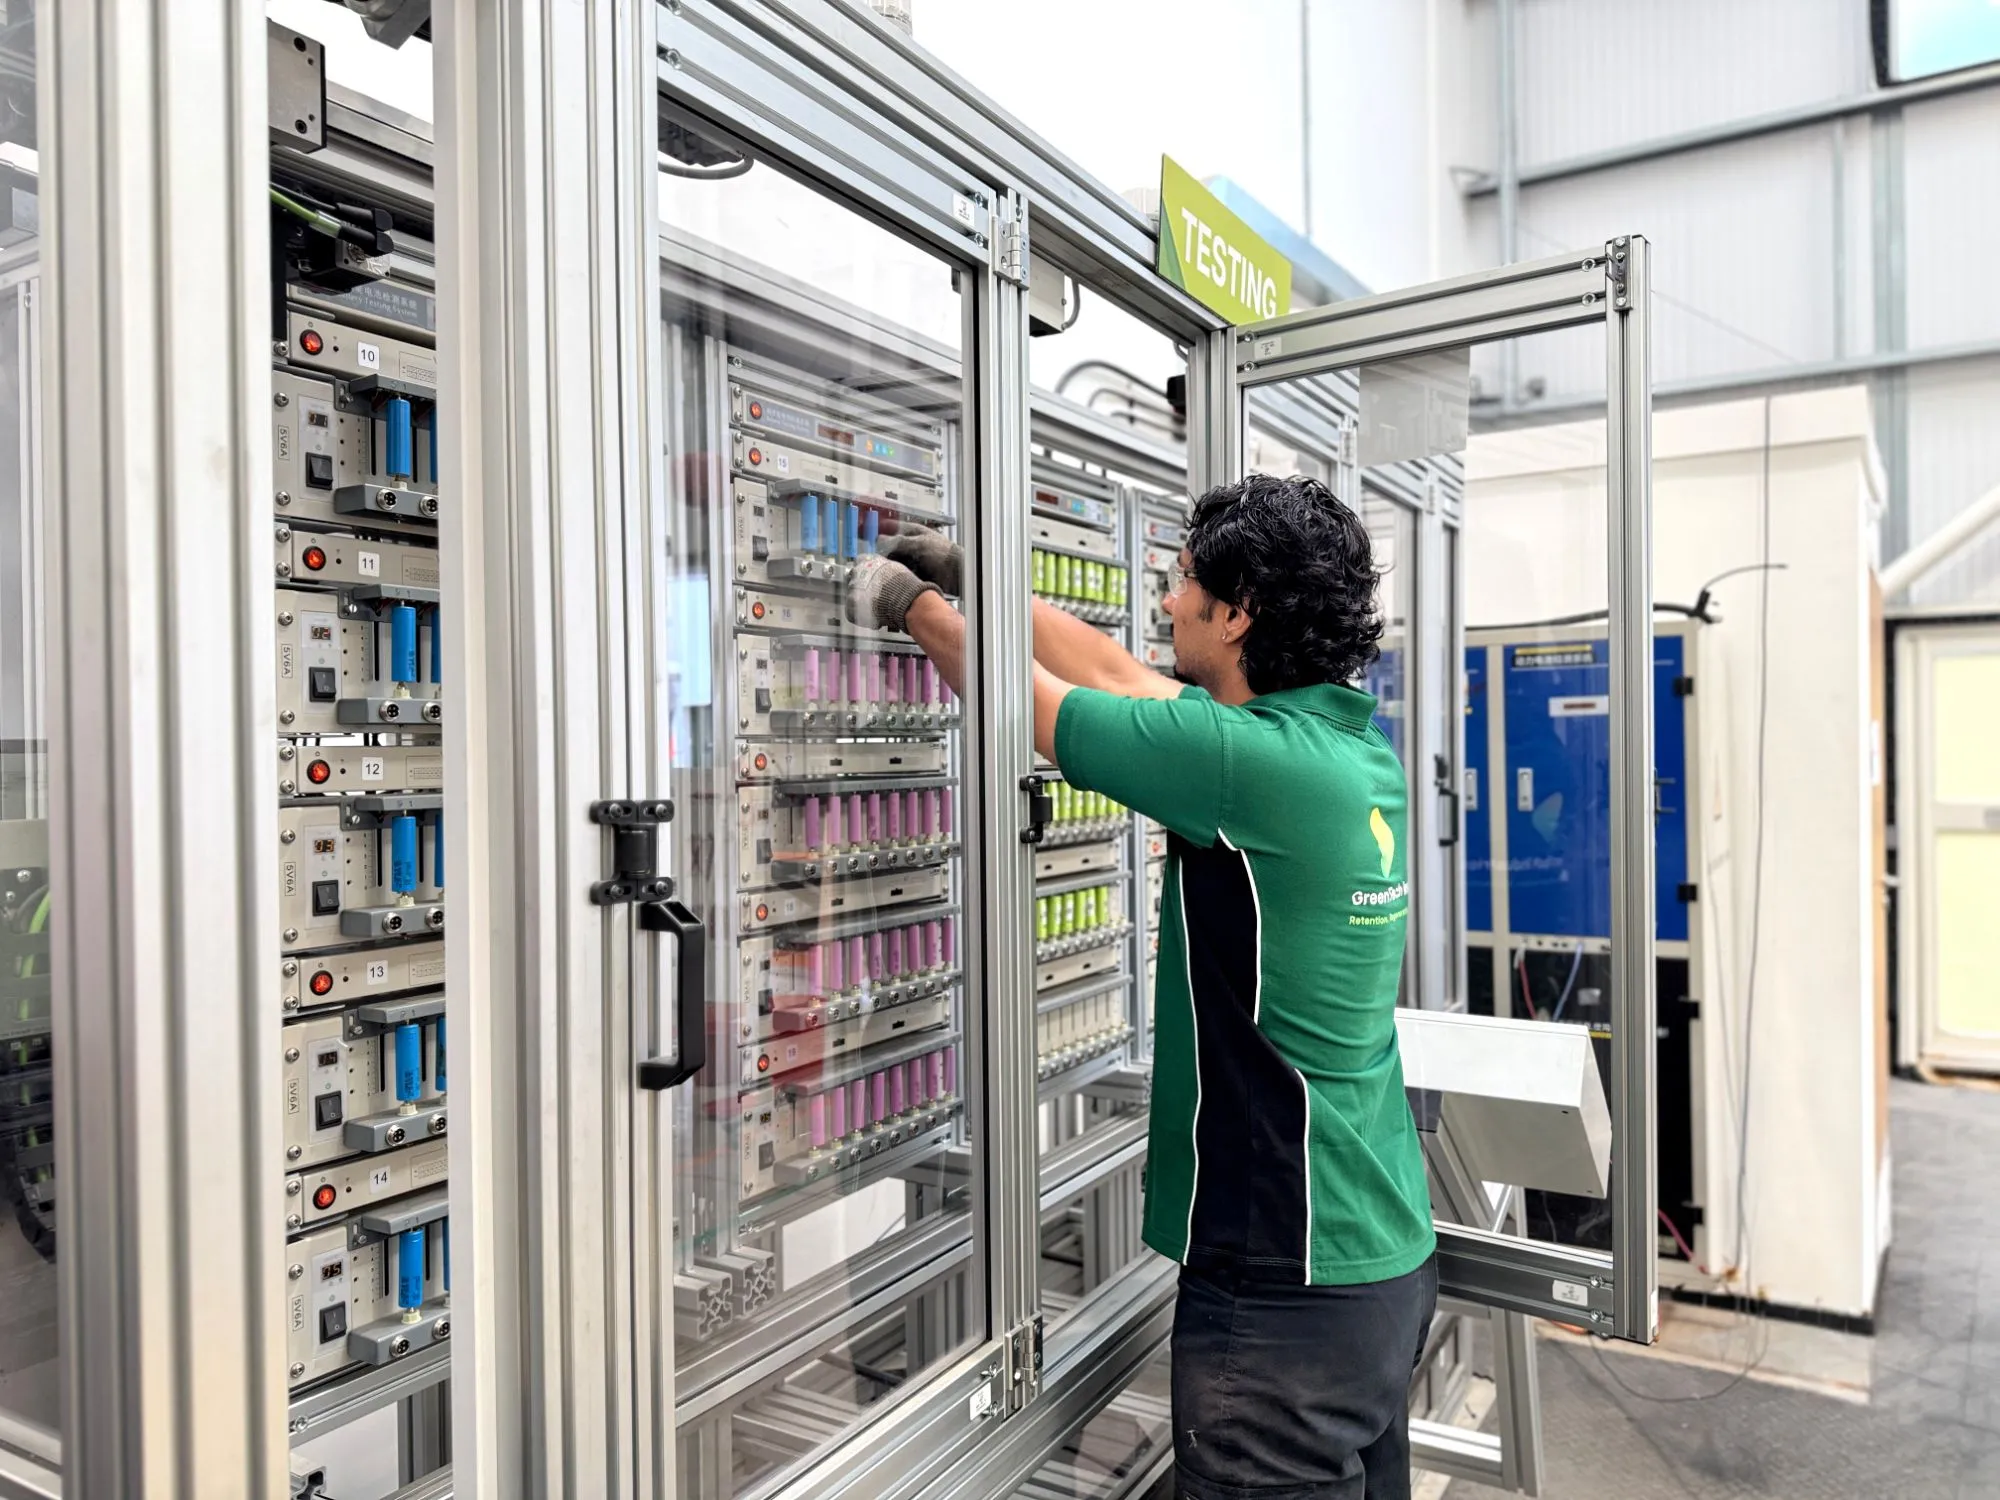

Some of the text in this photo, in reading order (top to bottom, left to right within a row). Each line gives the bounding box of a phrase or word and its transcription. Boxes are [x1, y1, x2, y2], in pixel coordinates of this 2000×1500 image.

[1181, 206, 1277, 320] TESTING
[361, 349, 375, 363] 10
[280, 428, 288, 457] 5V6A
[361, 558, 375, 570] 11
[283, 646, 291, 675] 5V6A
[365, 763, 380, 776] 12
[286, 864, 294, 893] 5V6A
[369, 966, 384, 978] 13
[289, 1082, 298, 1111] 5V6A
[373, 1172, 388, 1185] 14
[294, 1298, 302, 1328] 5V6A
